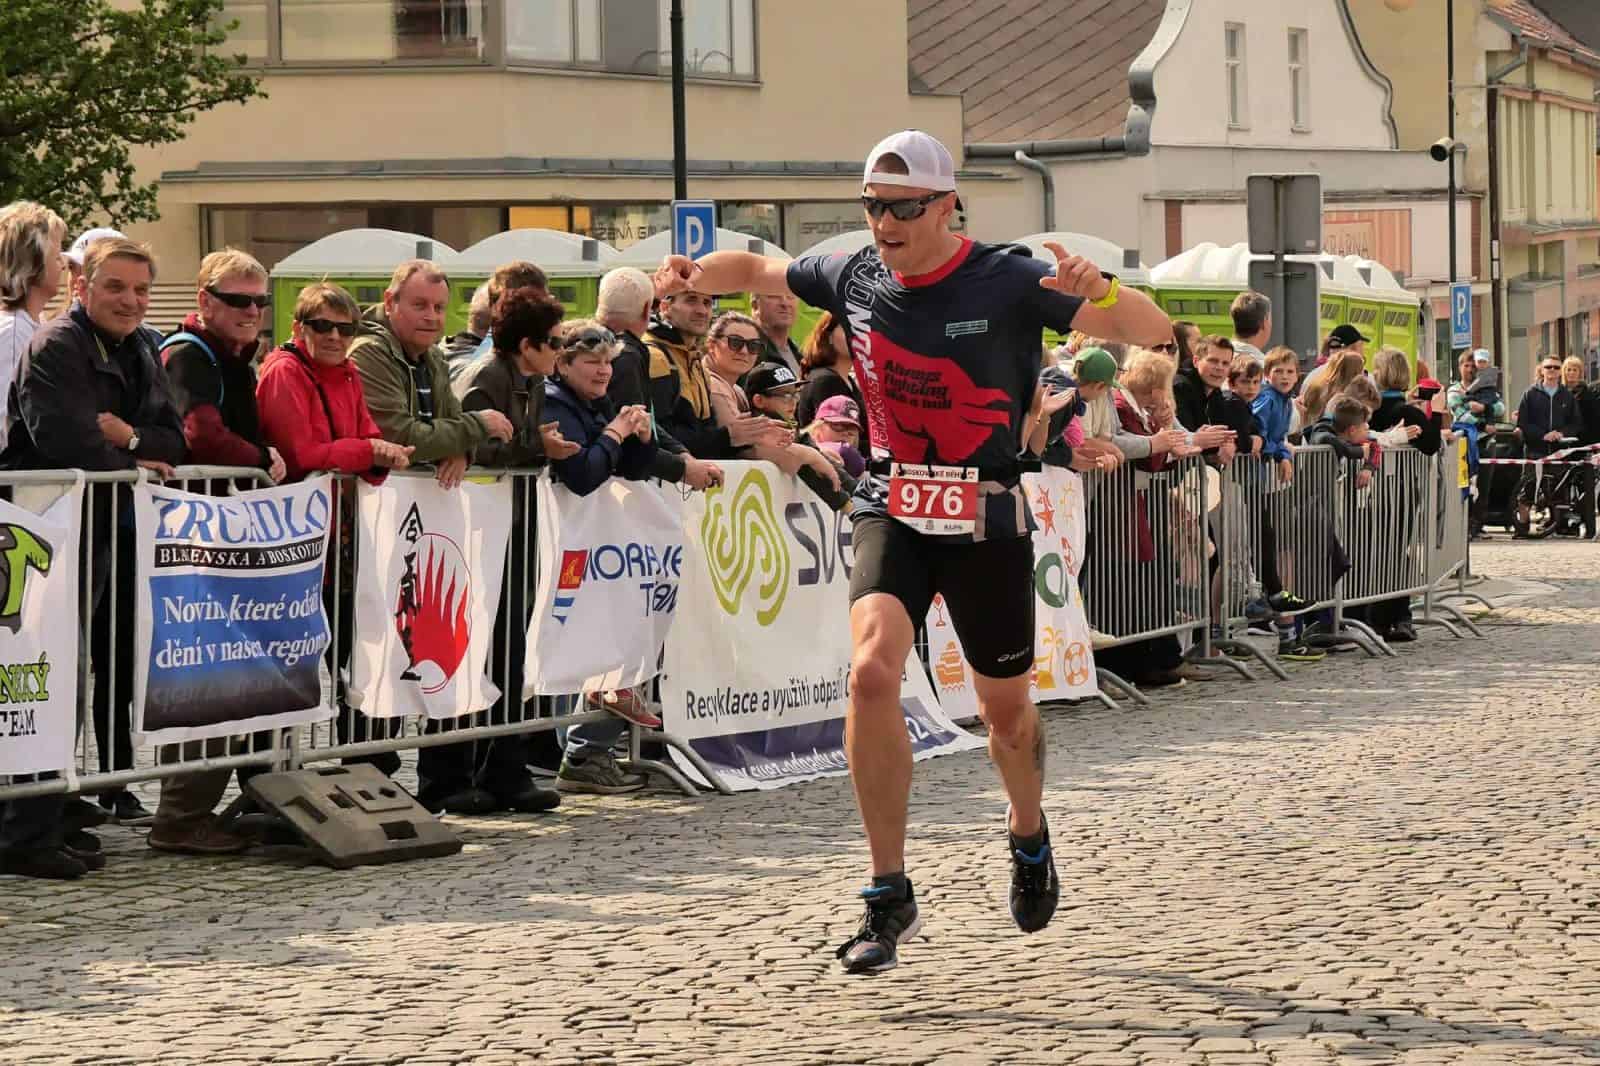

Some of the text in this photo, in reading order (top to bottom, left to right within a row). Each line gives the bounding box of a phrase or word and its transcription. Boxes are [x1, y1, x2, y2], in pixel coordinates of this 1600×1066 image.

[686, 215, 705, 259] P
[1456, 292, 1467, 327] P
[900, 483, 964, 516] 976
[230, 593, 287, 622] které
[156, 636, 203, 669] dění
[205, 642, 217, 664] v
[686, 685, 758, 723] Recyklace
[761, 689, 770, 712] a
[772, 675, 811, 717] využití
